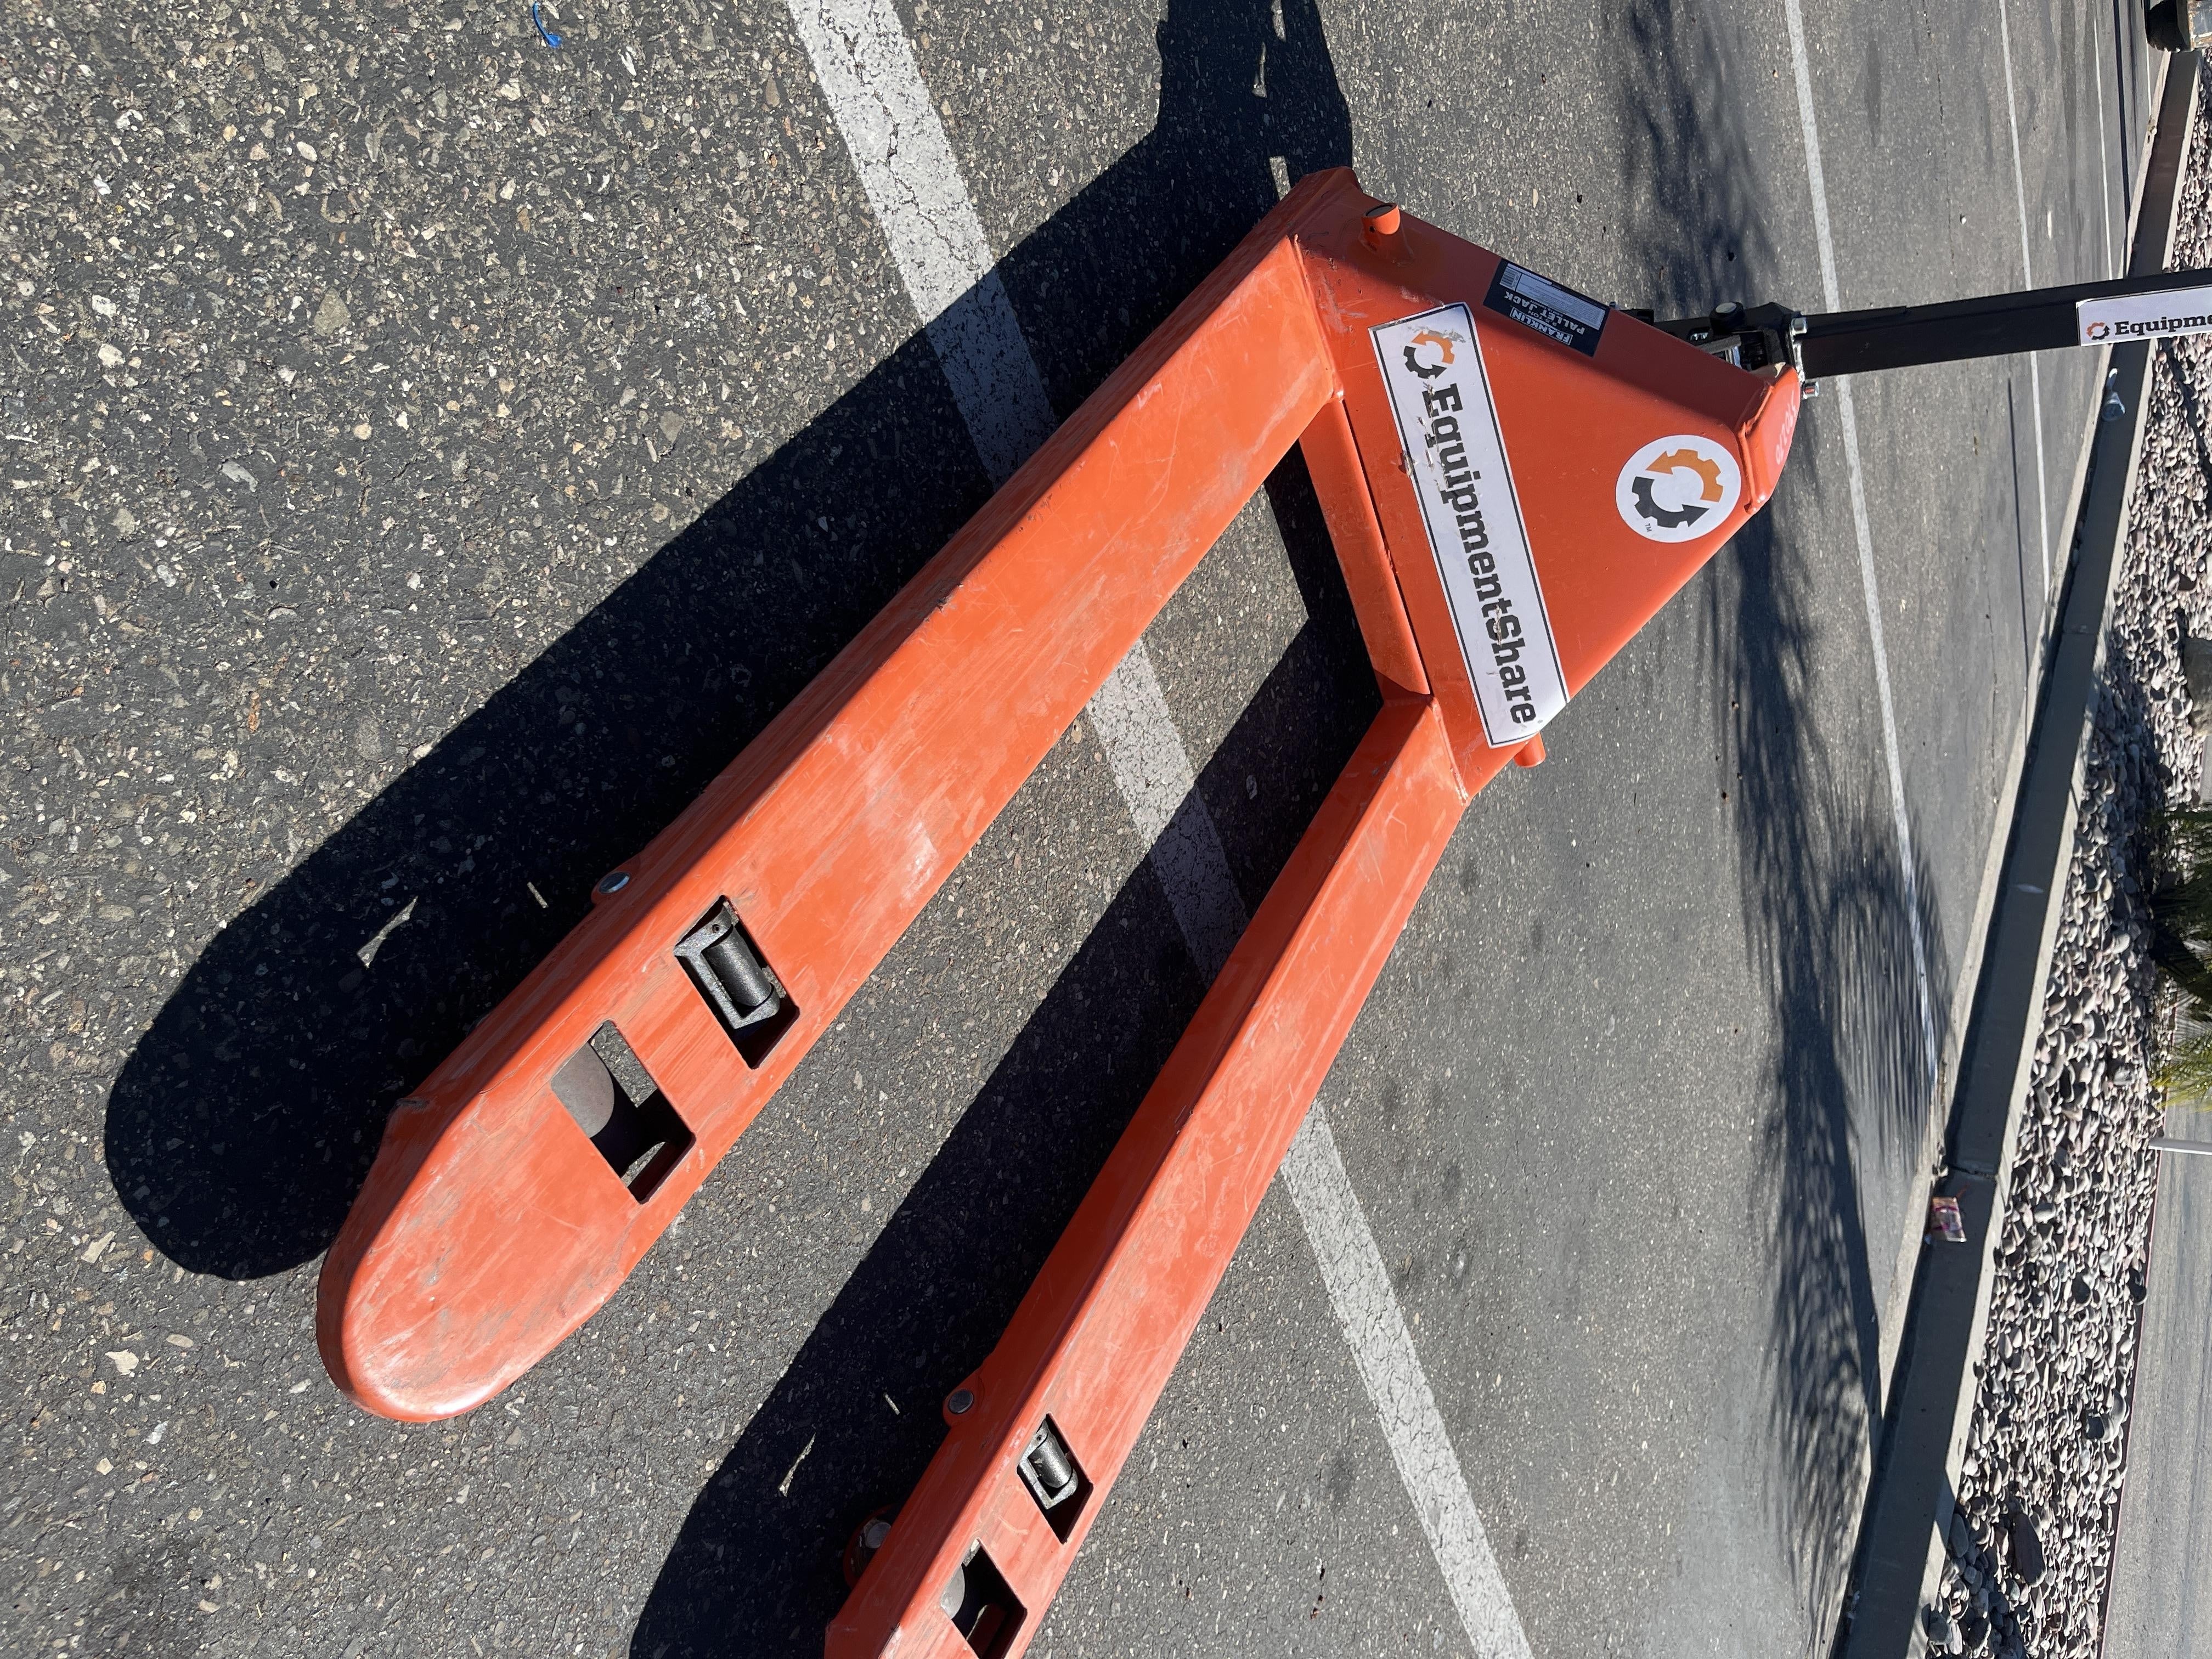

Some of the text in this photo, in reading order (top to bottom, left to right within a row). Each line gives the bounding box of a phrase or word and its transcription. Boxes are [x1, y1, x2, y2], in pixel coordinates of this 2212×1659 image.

[1504, 291, 1537, 311] JACK
[1512, 309, 1570, 343] FRANKLIN
[1528, 310, 1543, 320] TON
[1540, 309, 1585, 335] PALLET
[1421, 382, 1537, 725] EquipmentShare
